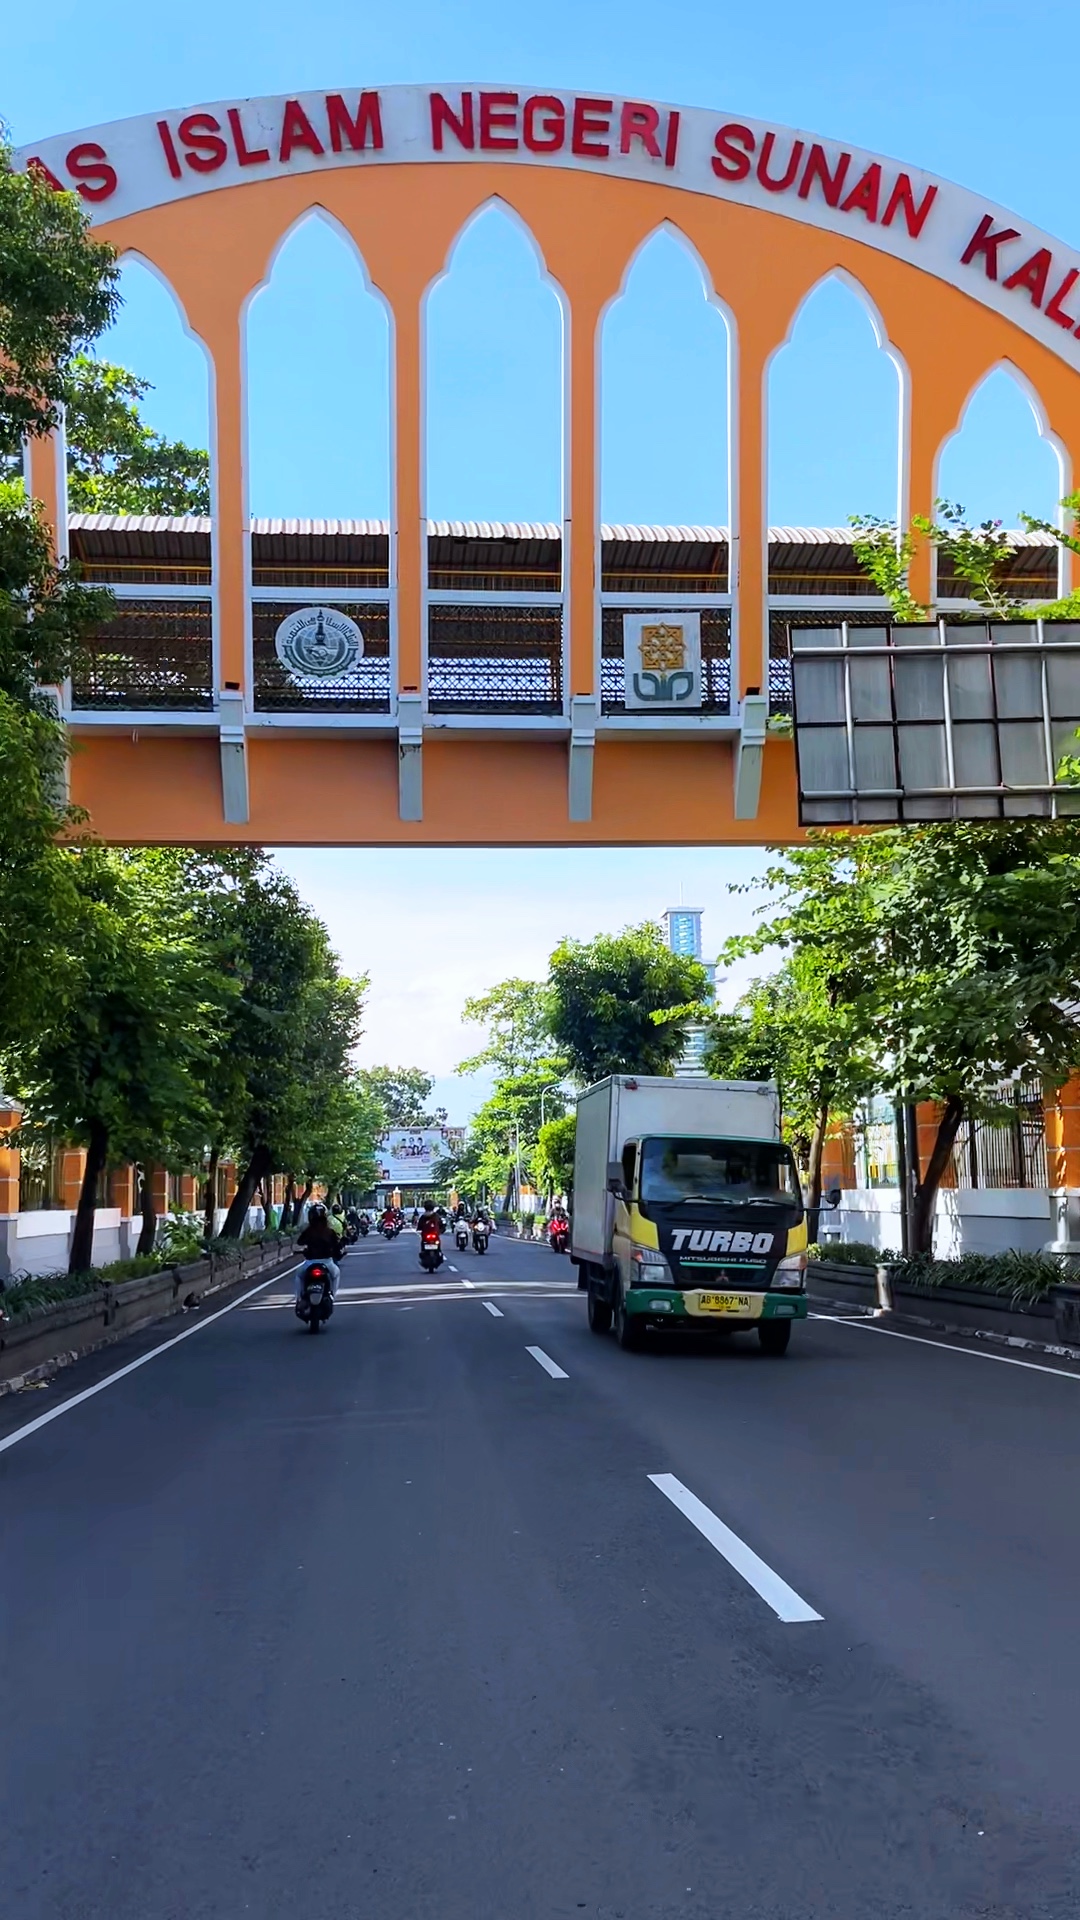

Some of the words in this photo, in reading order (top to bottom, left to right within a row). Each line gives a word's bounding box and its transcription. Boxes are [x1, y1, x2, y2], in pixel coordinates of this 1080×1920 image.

[156, 91, 384, 179] ISLAM
[430, 91, 680, 167] NEGERI
[711, 123, 938, 239] SUNAN
[671, 1229, 774, 1253] TURBO
